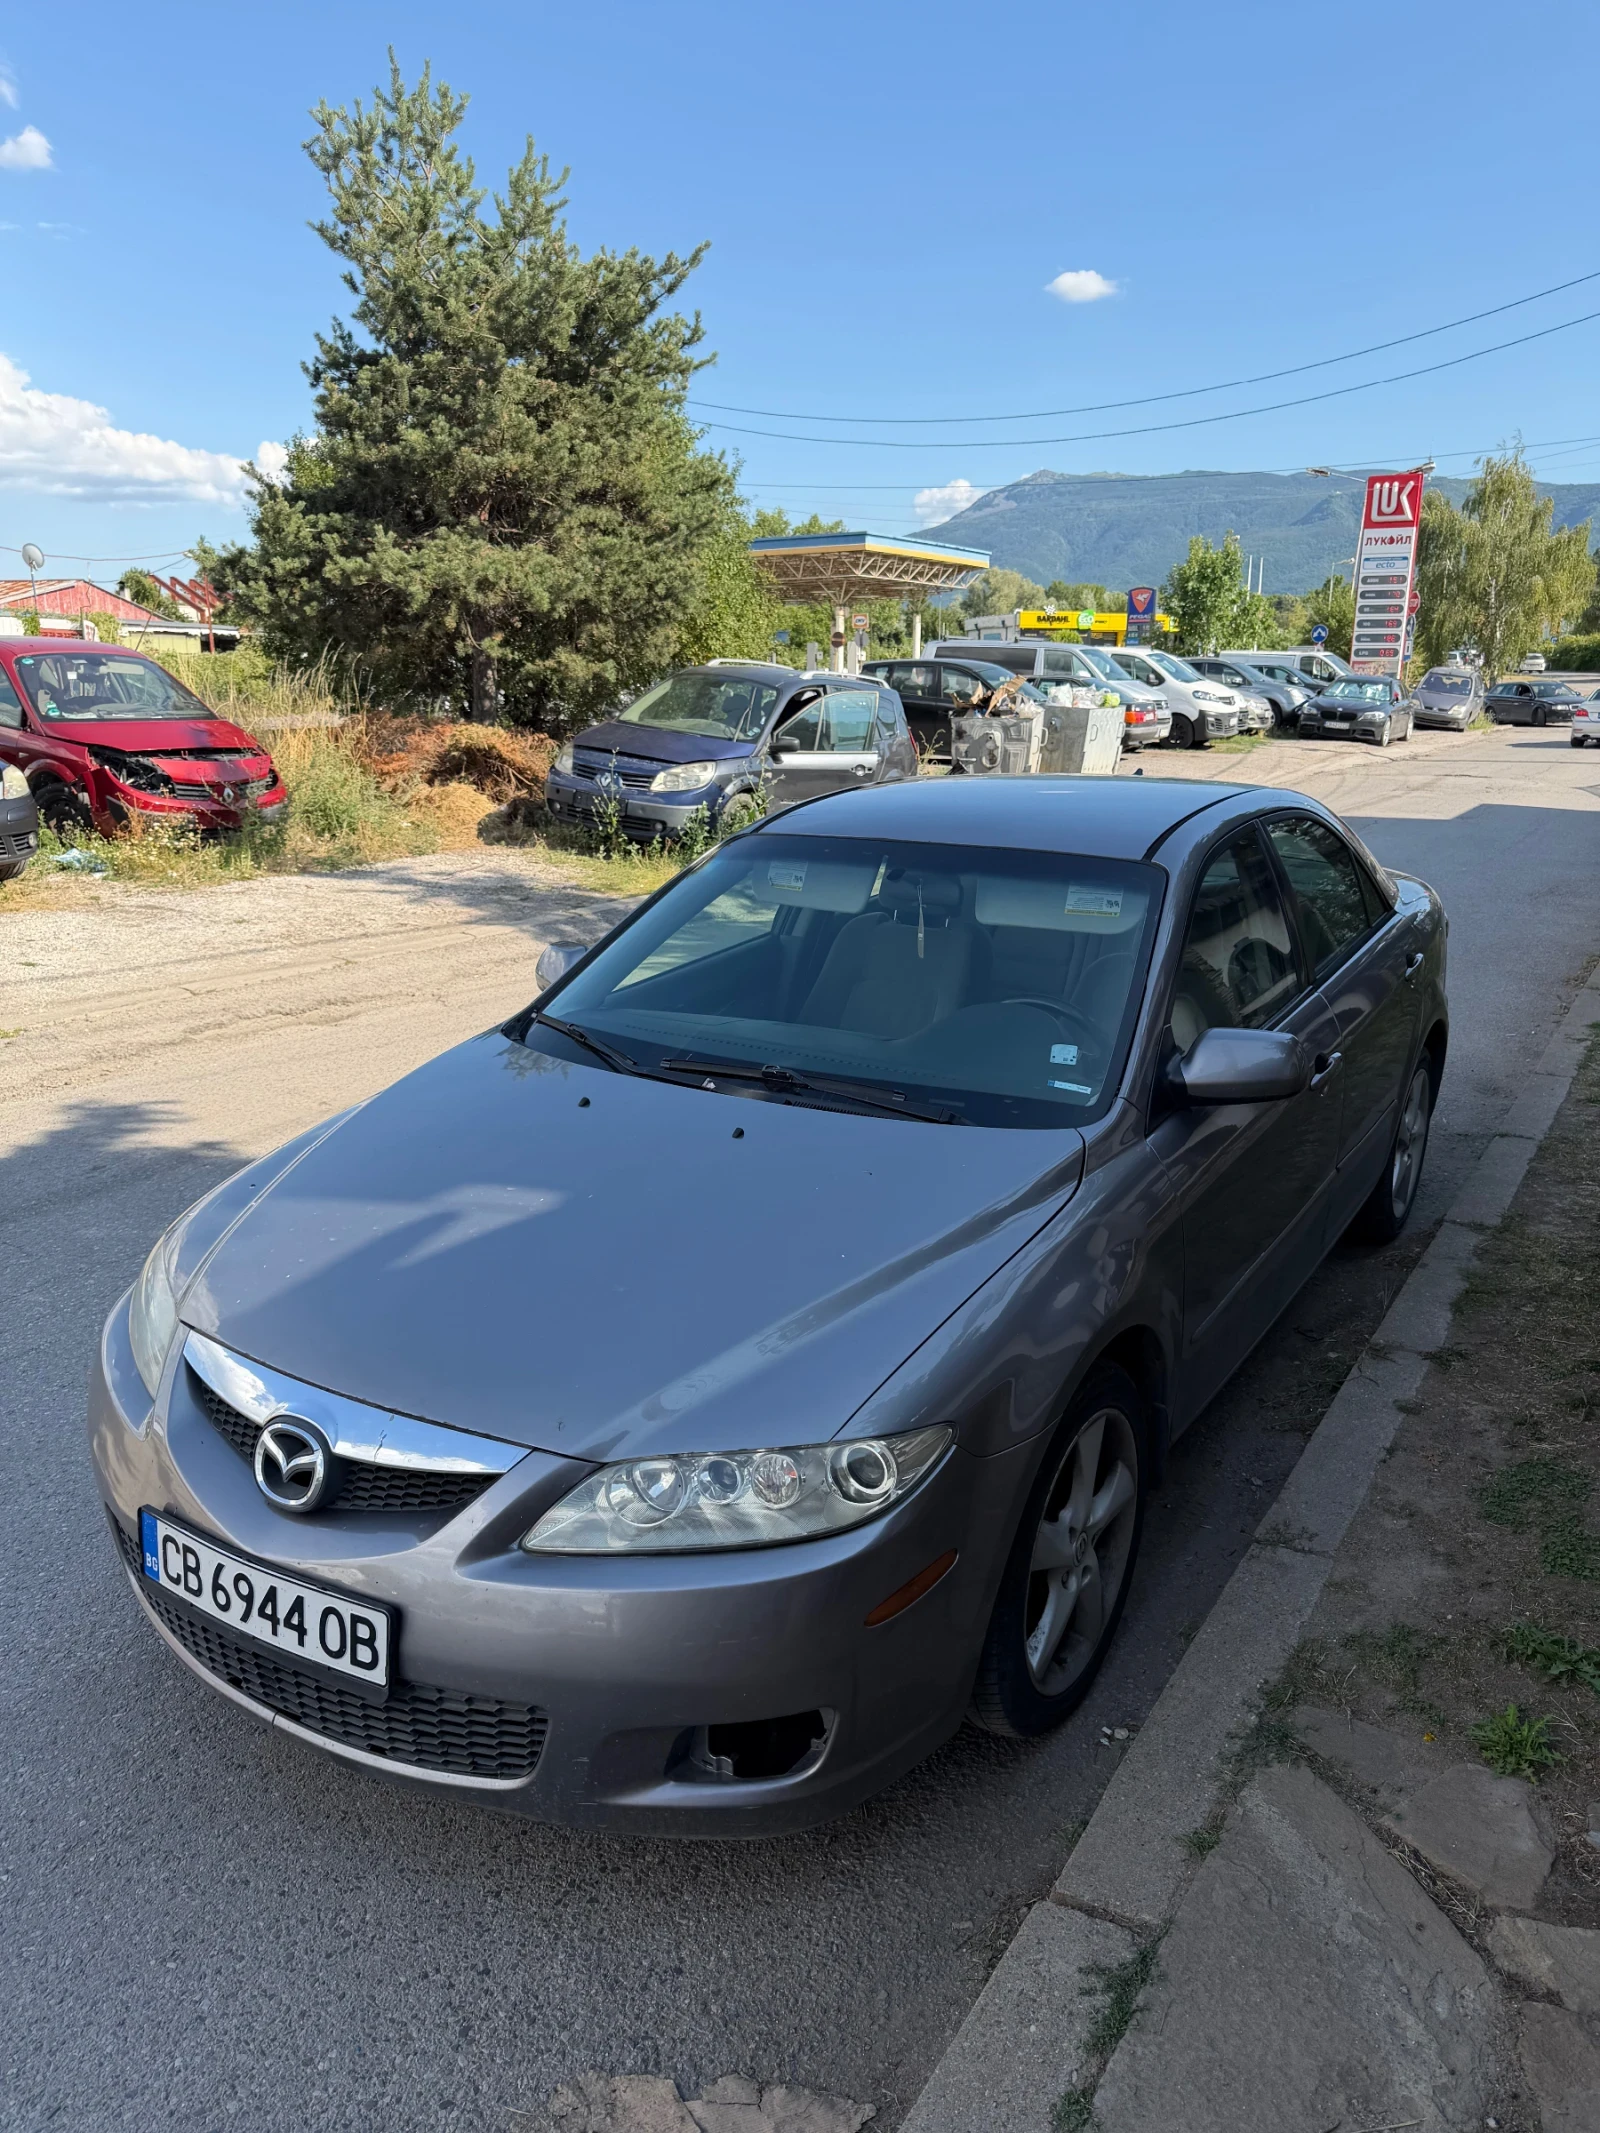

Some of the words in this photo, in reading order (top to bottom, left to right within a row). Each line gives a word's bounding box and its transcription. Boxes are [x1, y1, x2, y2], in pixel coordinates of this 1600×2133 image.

[1036, 615, 1070, 625] BARDAHL
[146, 1552, 158, 1572] BG
[162, 1534, 203, 1598] CB
[211, 1562, 307, 1648] 6944
[319, 1604, 379, 1671] OB
